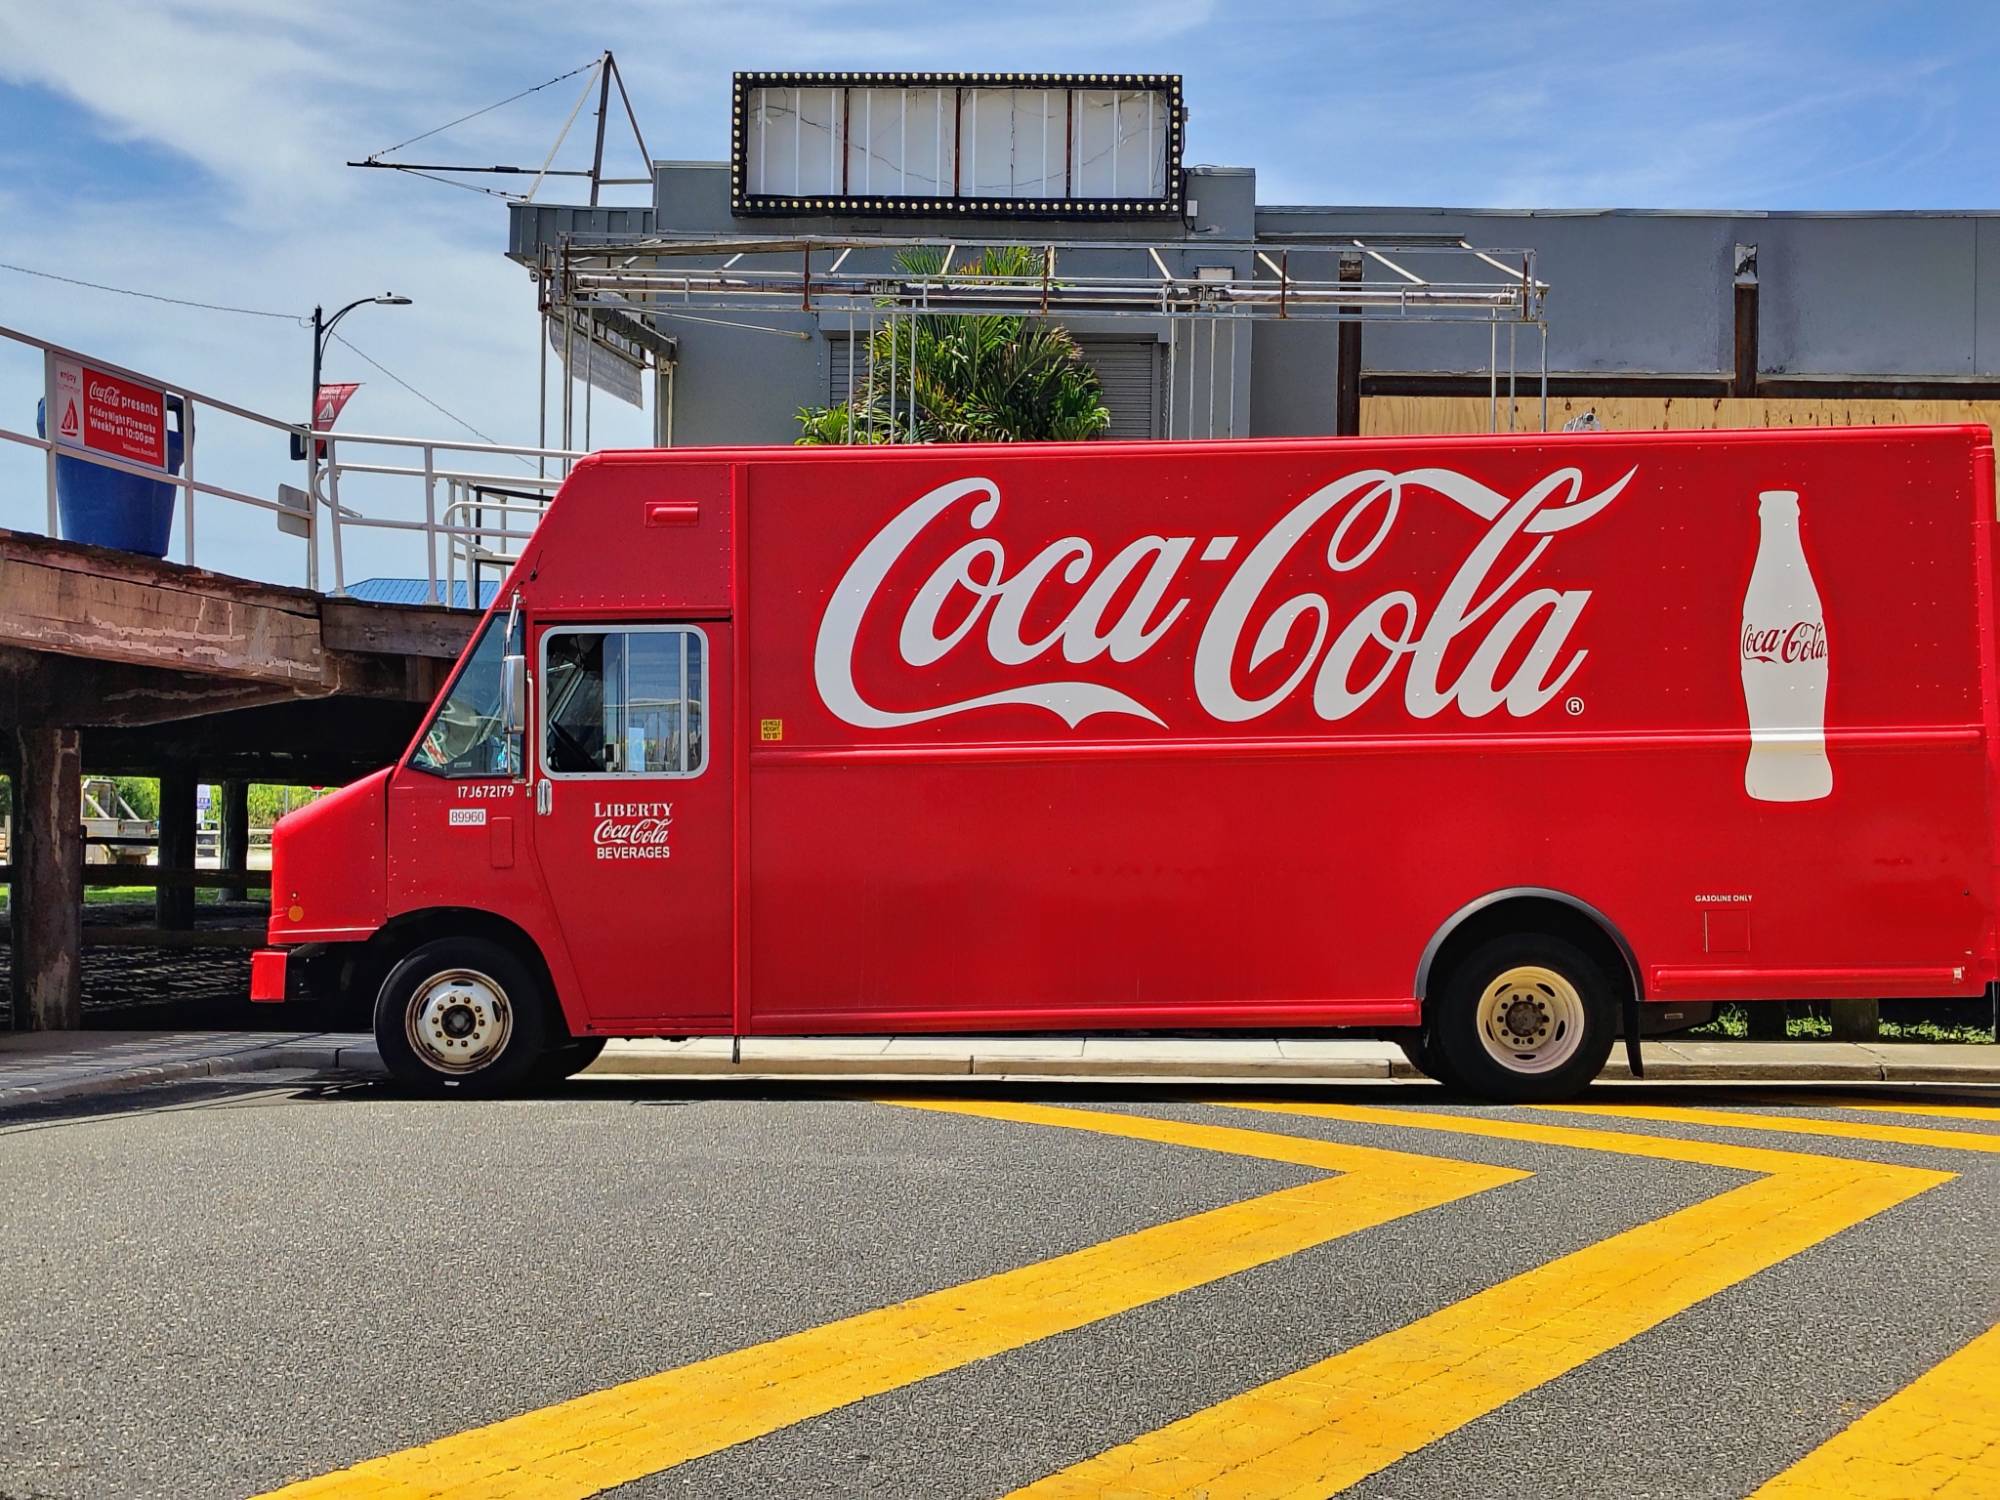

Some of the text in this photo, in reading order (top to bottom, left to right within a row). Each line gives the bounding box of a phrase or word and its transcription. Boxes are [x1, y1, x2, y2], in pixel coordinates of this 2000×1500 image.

[121, 396, 159, 417] presents
[89, 405, 157, 434] Friday Night Fireworks
[89, 417, 115, 435] Weekly
[116, 425, 124, 436] at
[125, 427, 144, 442] 10:00
[813, 464, 1638, 729] Coca-Cola
[1742, 621, 1827, 664] Coca-Cola
[451, 810, 485, 823] 89960
[594, 802, 674, 817] LIBERTY
[593, 818, 673, 845] Coca-Cola
[596, 846, 671, 859] BEVERAGES
[1694, 894, 1753, 902] GASOLINE ONLY
